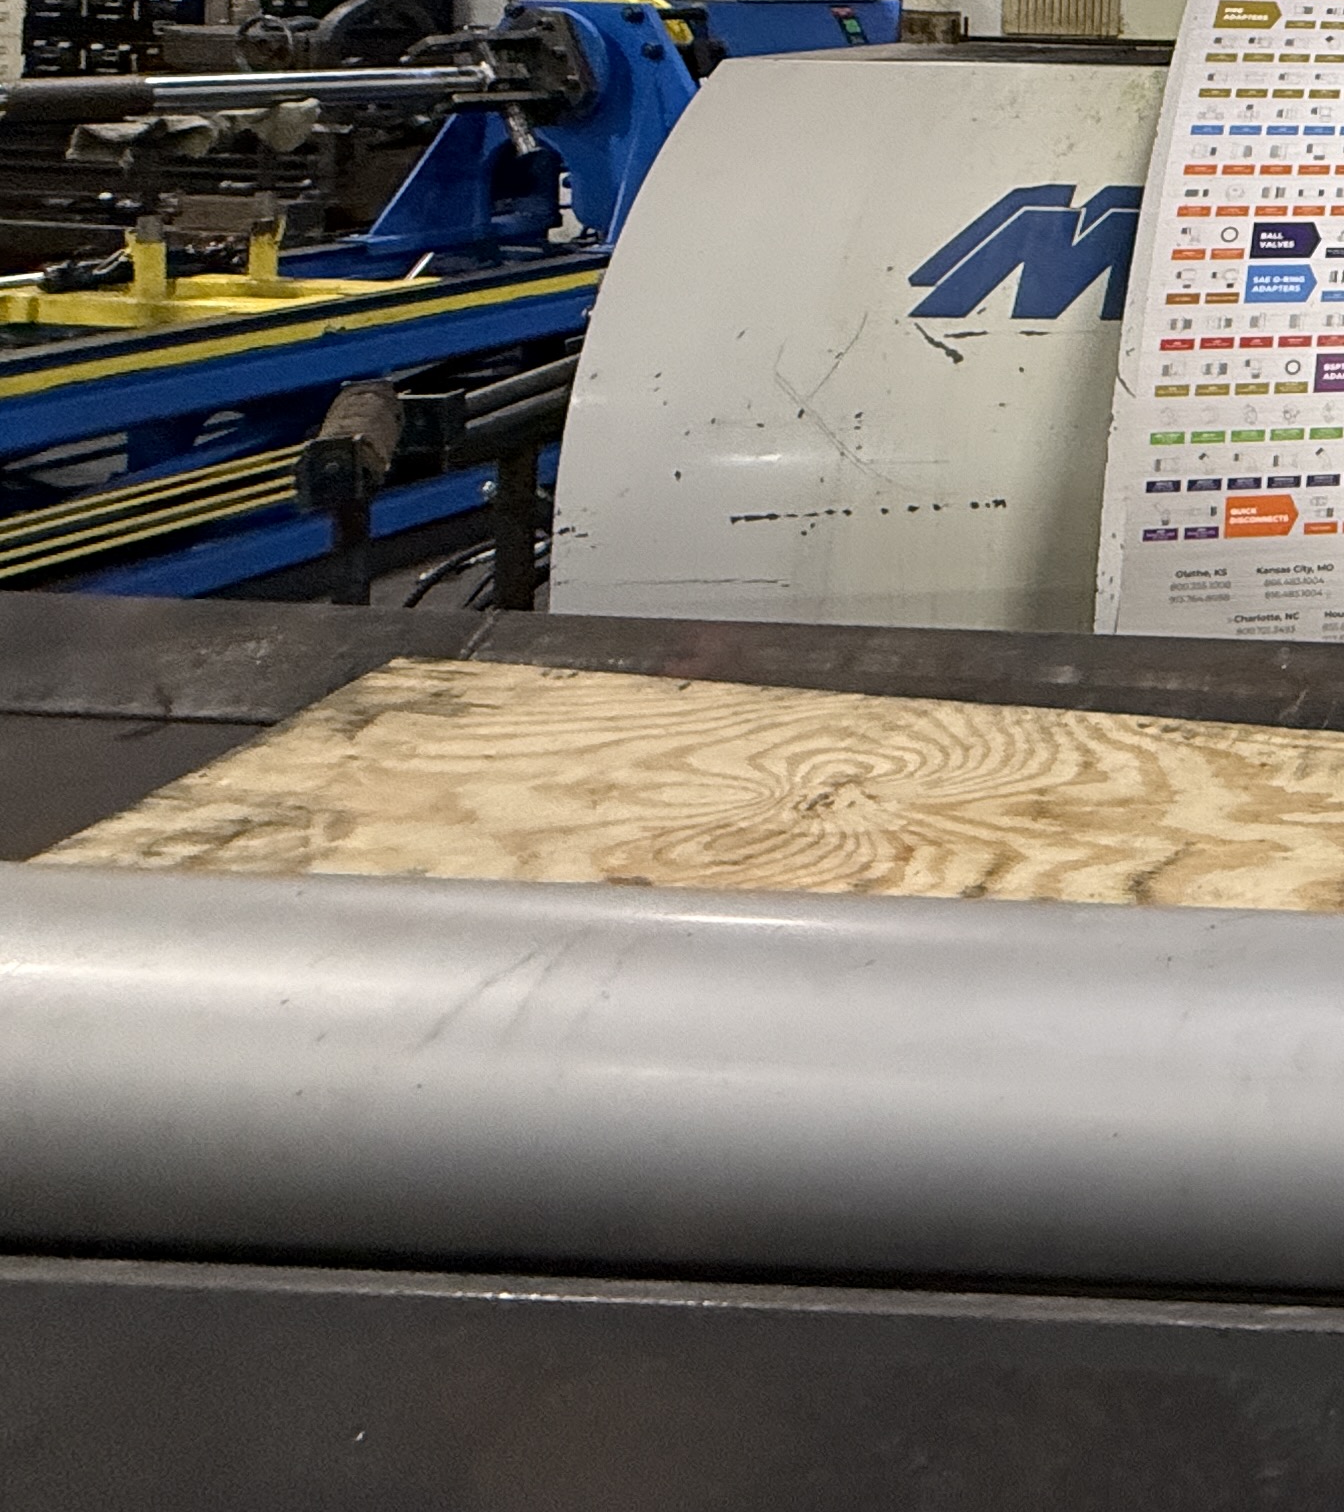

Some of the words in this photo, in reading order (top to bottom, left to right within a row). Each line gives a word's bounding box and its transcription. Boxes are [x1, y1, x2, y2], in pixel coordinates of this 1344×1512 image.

[1259, 231, 1284, 239] BALL
[1259, 240, 1295, 249] VALVES
[1252, 275, 1272, 284] SAE
[1273, 275, 1305, 284] O-RING
[1251, 284, 1301, 293] ADAPTERS
[1229, 506, 1257, 515] QUICK
[1228, 514, 1289, 525] DISCONNECTS
[1214, 569, 1228, 577] KS
[1256, 566, 1291, 575] Kansas
[1293, 564, 1315, 575] City,
[1317, 563, 1335, 572] MO
[1234, 613, 1282, 623] Charlotte,
[1285, 612, 1300, 620] NC
